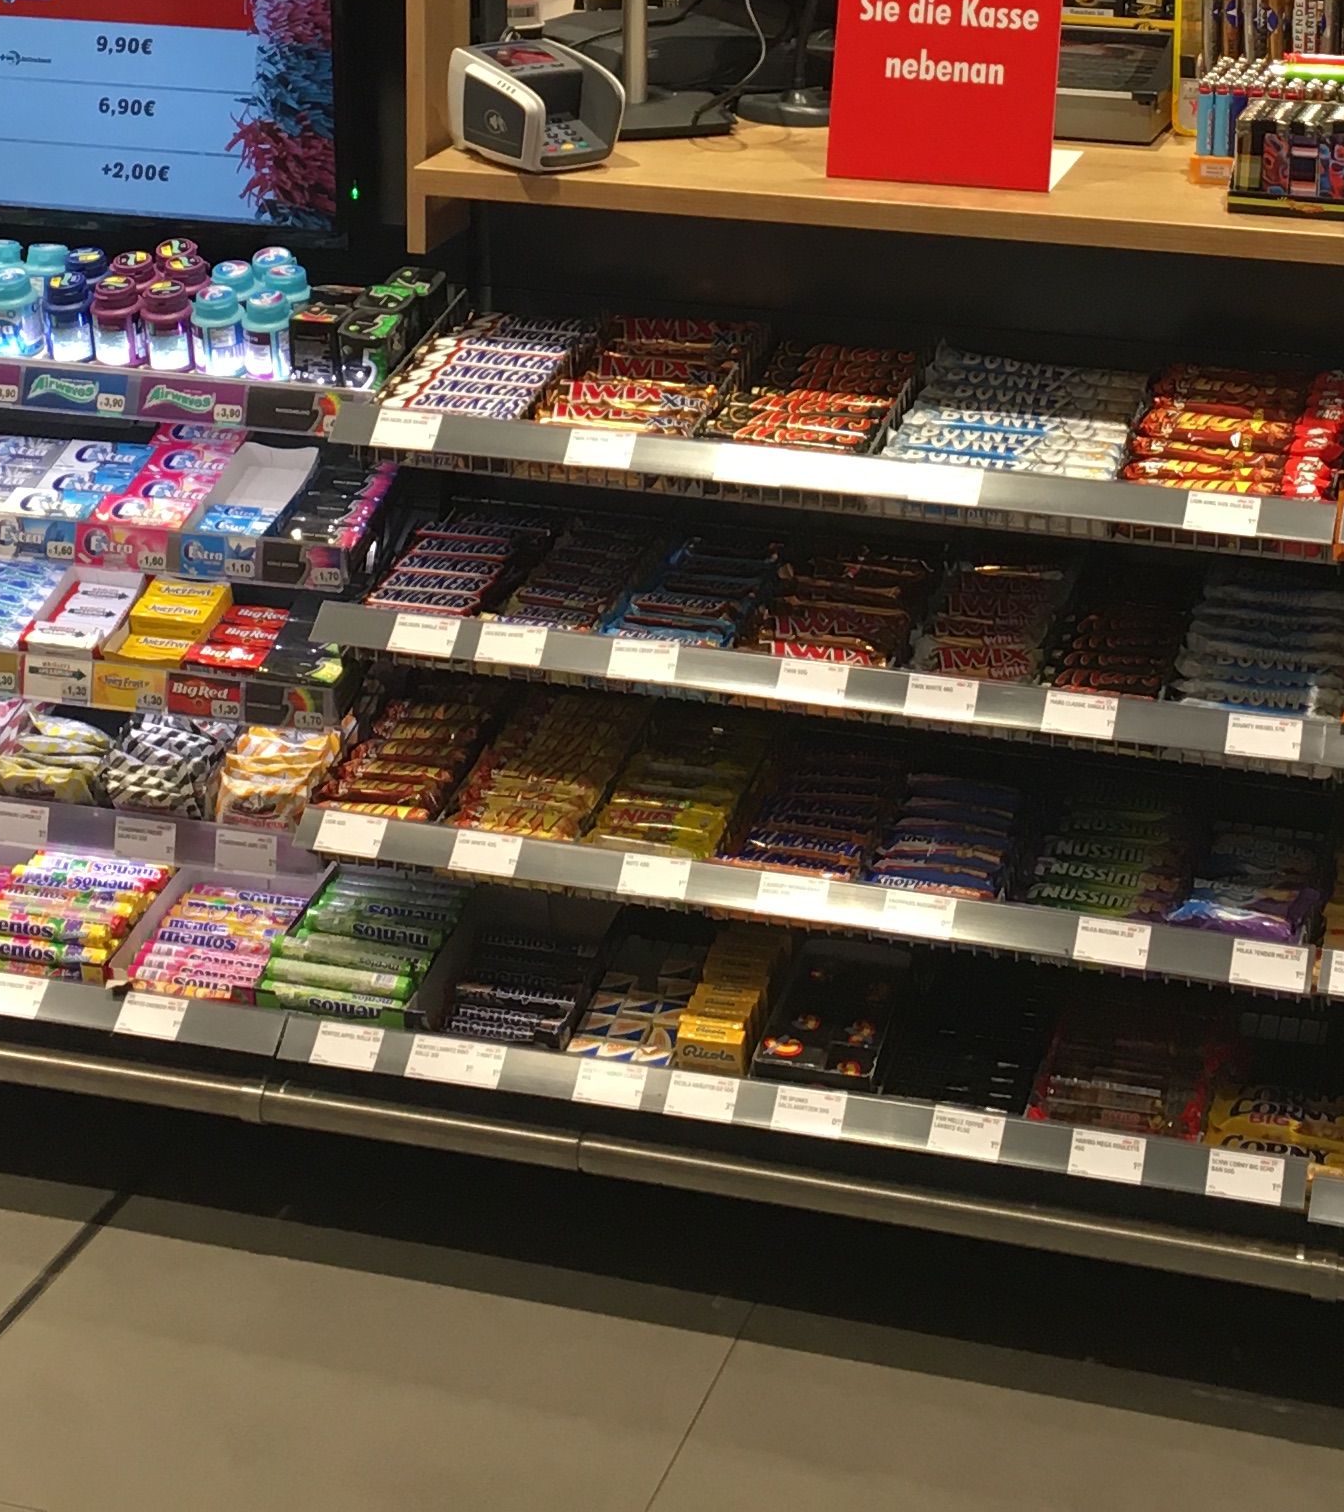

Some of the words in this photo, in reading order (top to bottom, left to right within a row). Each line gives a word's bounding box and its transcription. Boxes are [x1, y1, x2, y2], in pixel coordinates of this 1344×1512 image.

[95, 33, 154, 57] 9,90€
[884, 48, 1004, 86] nebenan
[97, 96, 156, 119] 6,90€
[101, 160, 170, 183] +2,00€
[29, 375, 100, 402] Airwaves
[144, 386, 217, 413] Airwaves
[570, 380, 662, 403] TWIX
[388, 572, 493, 591] SNICKERS
[933, 647, 1031, 670] TWIX
[159, 928, 237, 952] mentos
[352, 922, 430, 948] mentos
[682, 1044, 736, 1061] Ricola
